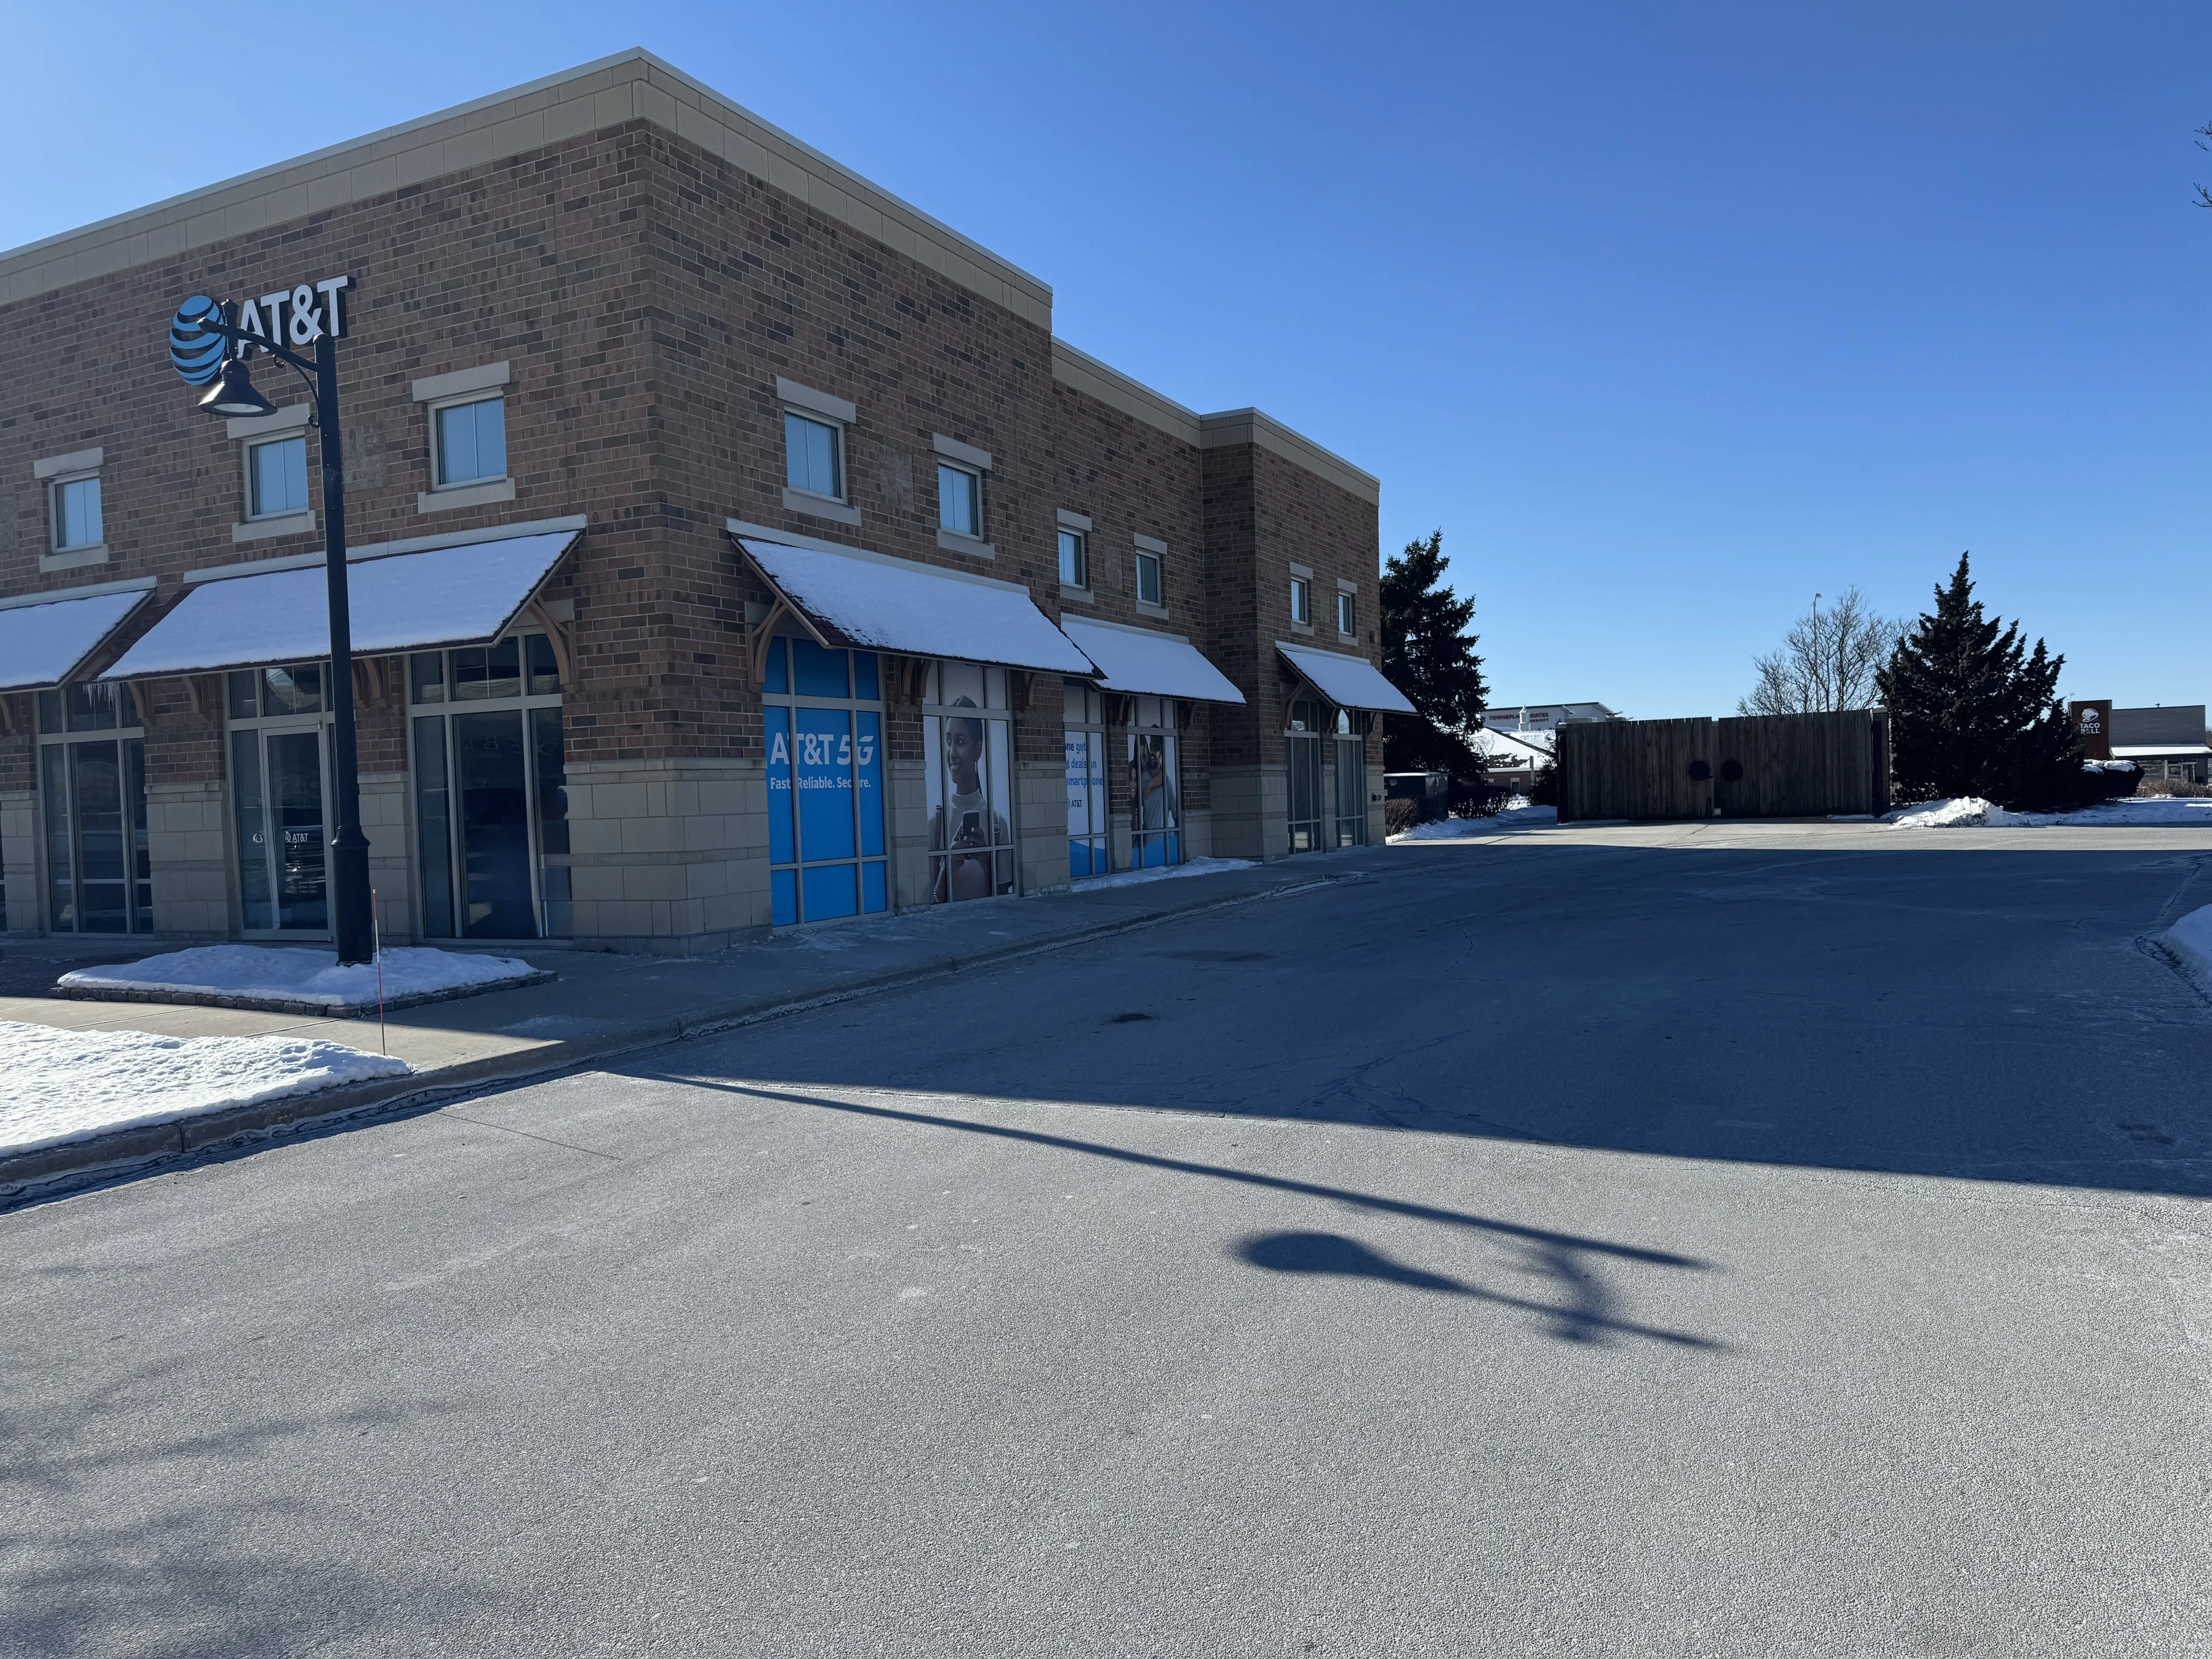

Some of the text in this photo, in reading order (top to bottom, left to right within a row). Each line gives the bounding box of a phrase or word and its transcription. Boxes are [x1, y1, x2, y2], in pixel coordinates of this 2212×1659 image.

[237, 275, 348, 359] AT&T
[770, 732, 874, 766] AT&T 5G
[1076, 742, 1086, 754] get
[1071, 758, 1087, 769] deals
[798, 776, 835, 789] Reliable.
[837, 777, 871, 788] Secre.
[1067, 776, 1103, 788] smartpone
[1071, 800, 1082, 808] AT&T
[292, 833, 309, 842] AT&T
